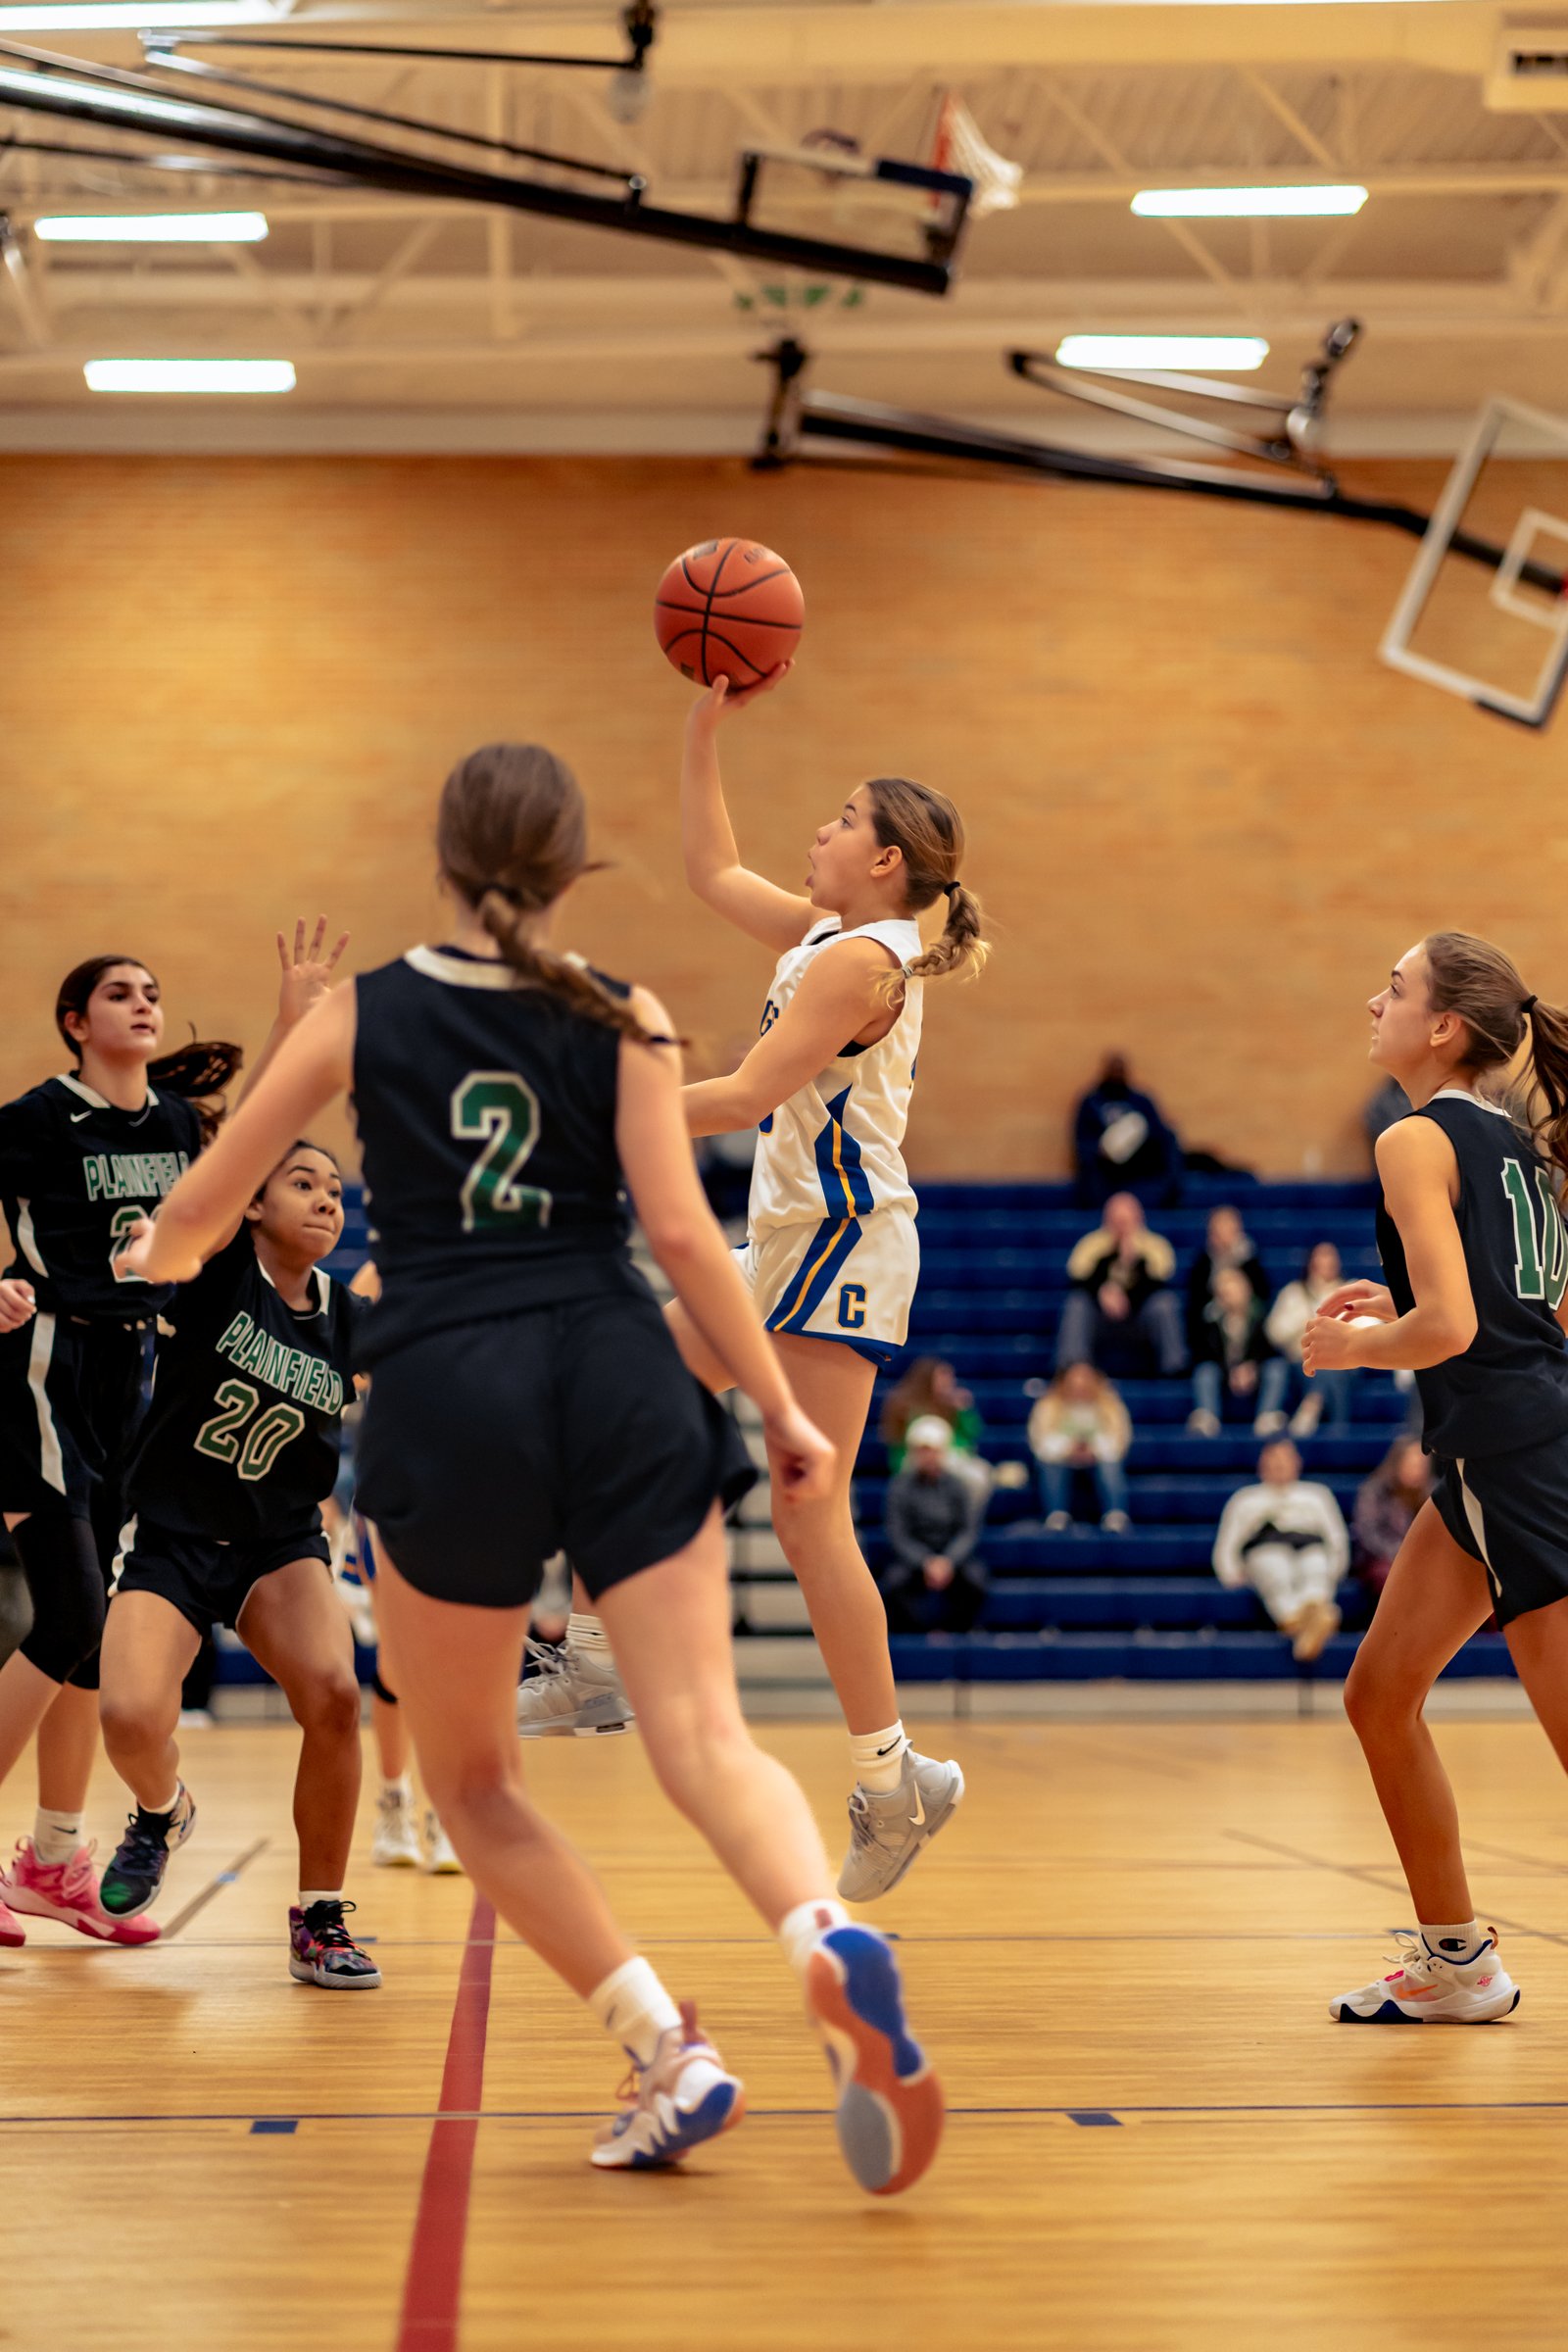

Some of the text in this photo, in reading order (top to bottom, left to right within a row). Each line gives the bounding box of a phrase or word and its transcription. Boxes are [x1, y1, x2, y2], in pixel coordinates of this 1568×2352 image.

[449, 1068, 554, 1233] 2
[1500, 1156, 1568, 1311] 10
[836, 1280, 869, 1331] C
[215, 1310, 344, 1415] PLAINFIELD
[193, 1377, 306, 1481] 20
